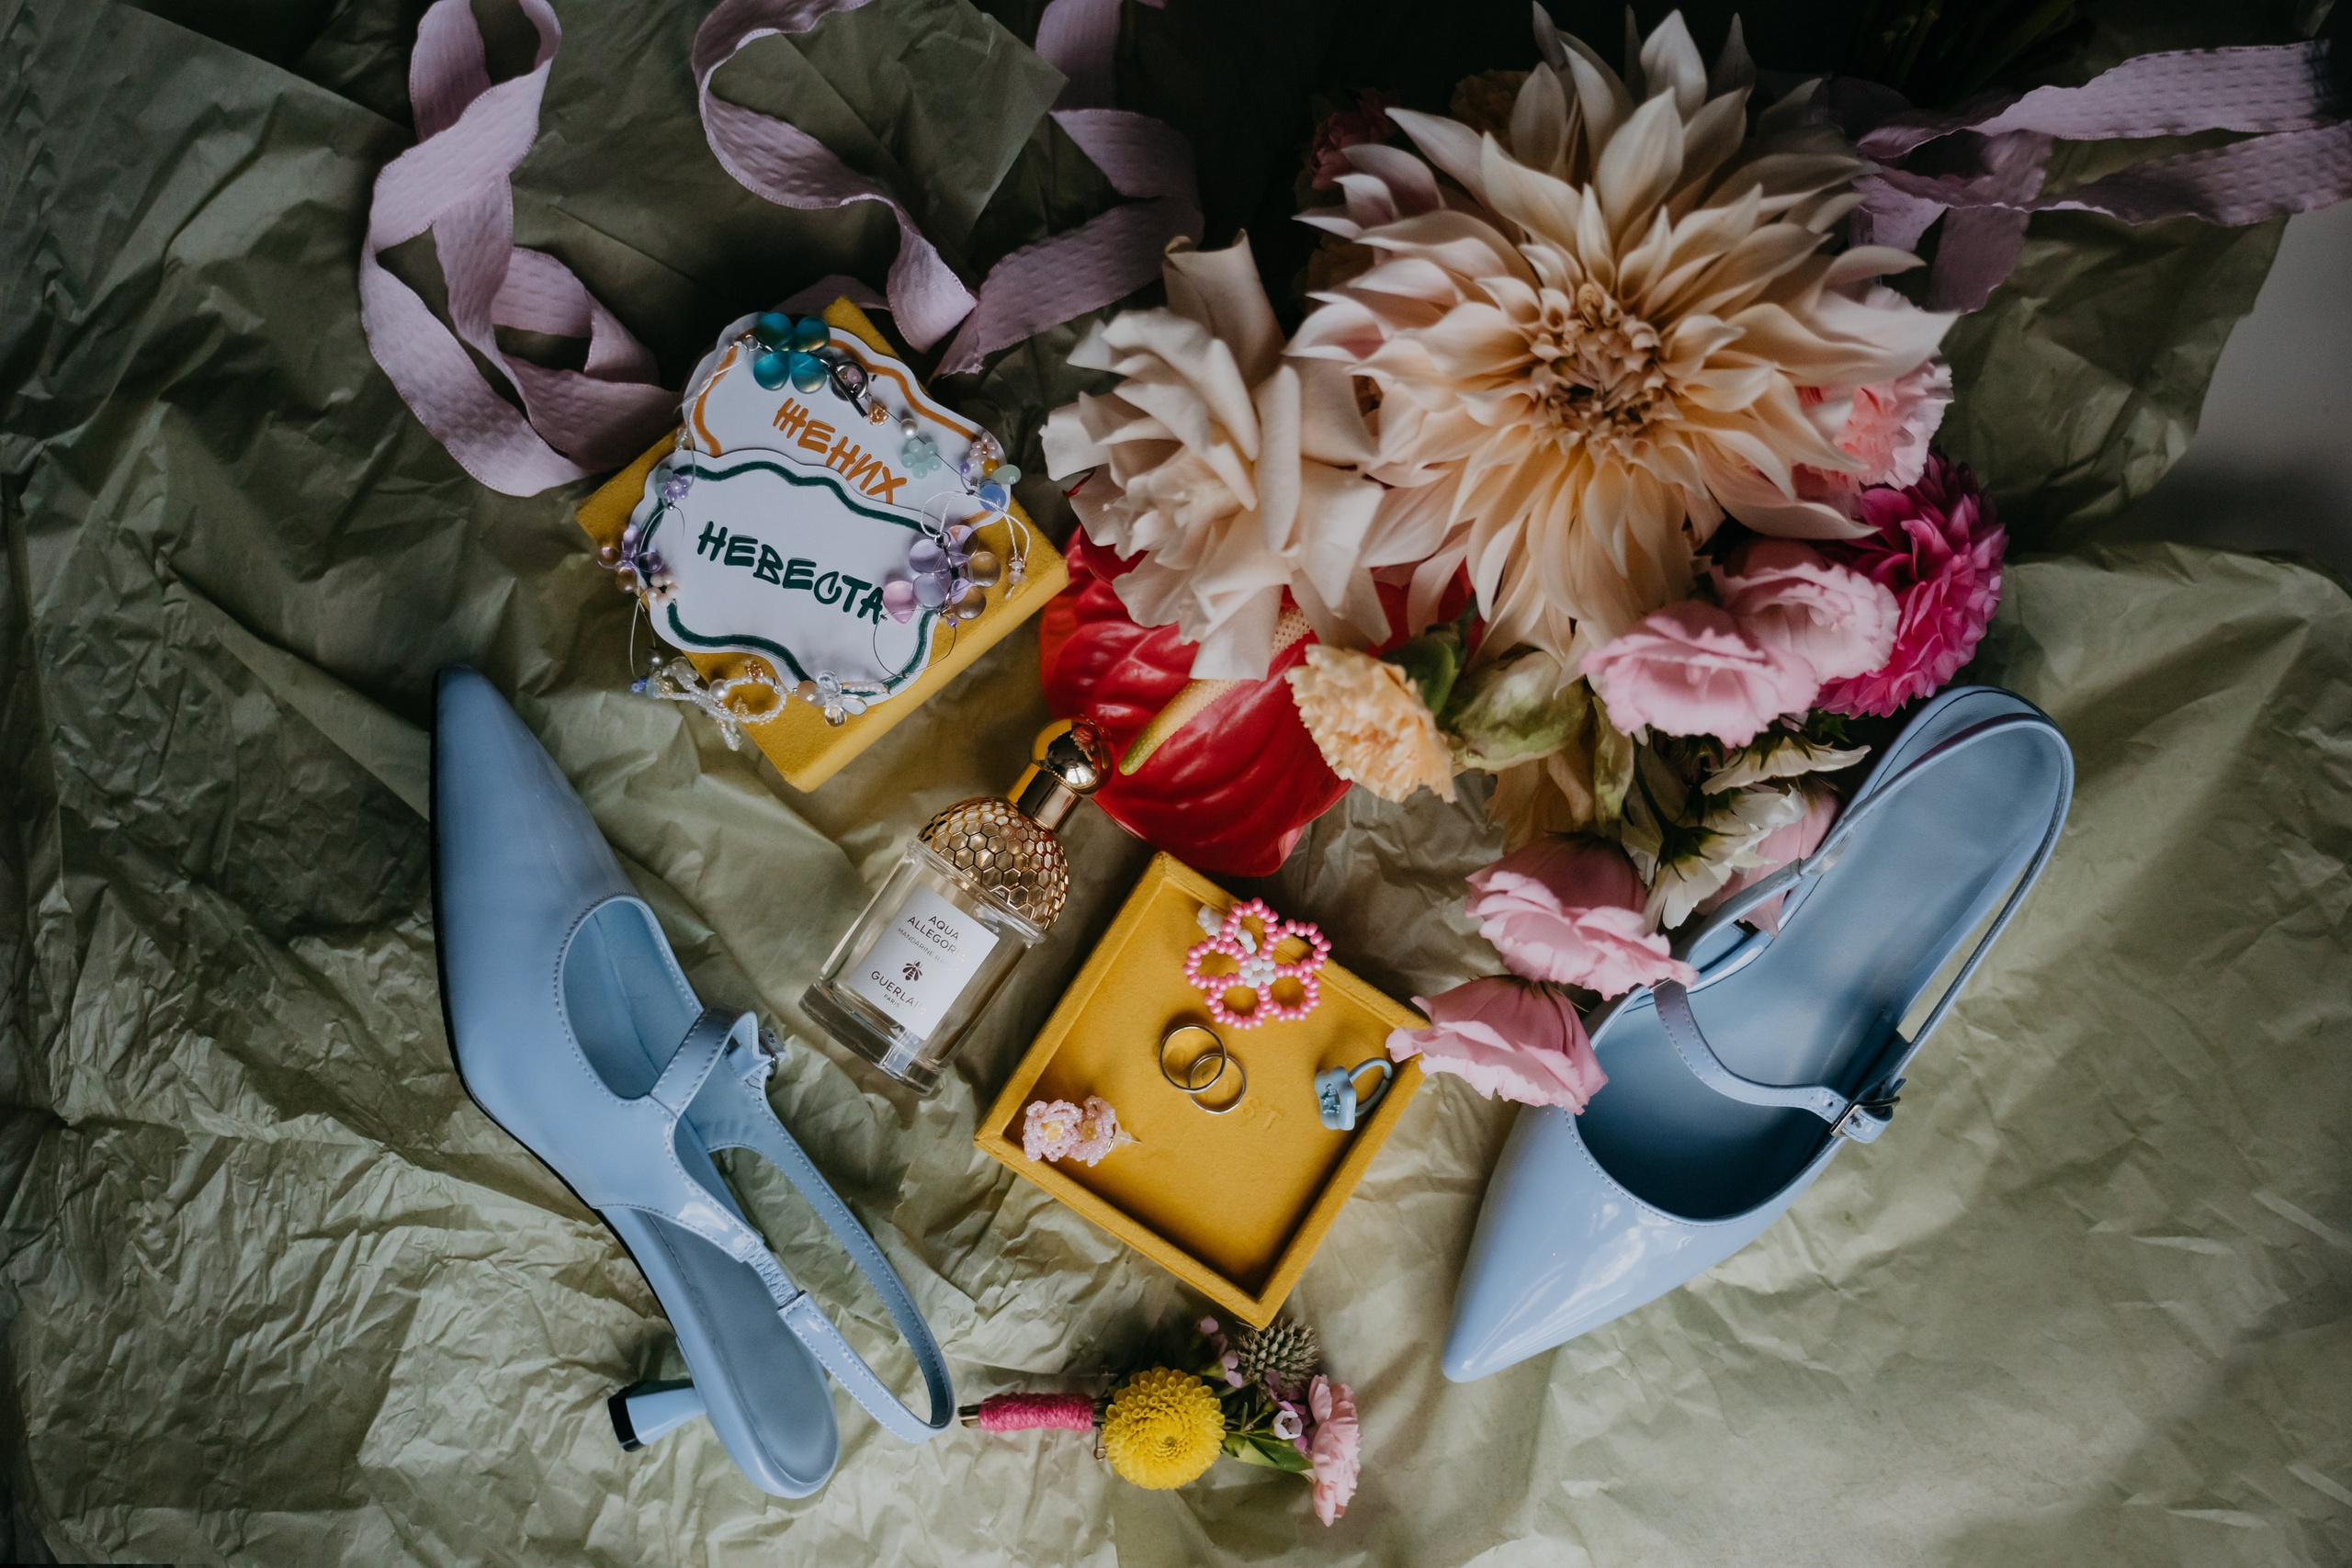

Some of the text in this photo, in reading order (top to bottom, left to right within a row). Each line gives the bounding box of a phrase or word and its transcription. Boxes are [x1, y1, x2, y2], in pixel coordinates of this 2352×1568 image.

[773, 397, 908, 504] ЖЕНИХ
[696, 521, 885, 625] НЕВЕСТА
[928, 915, 959, 941] AQUA
[883, 993, 901, 1009] PARIS
